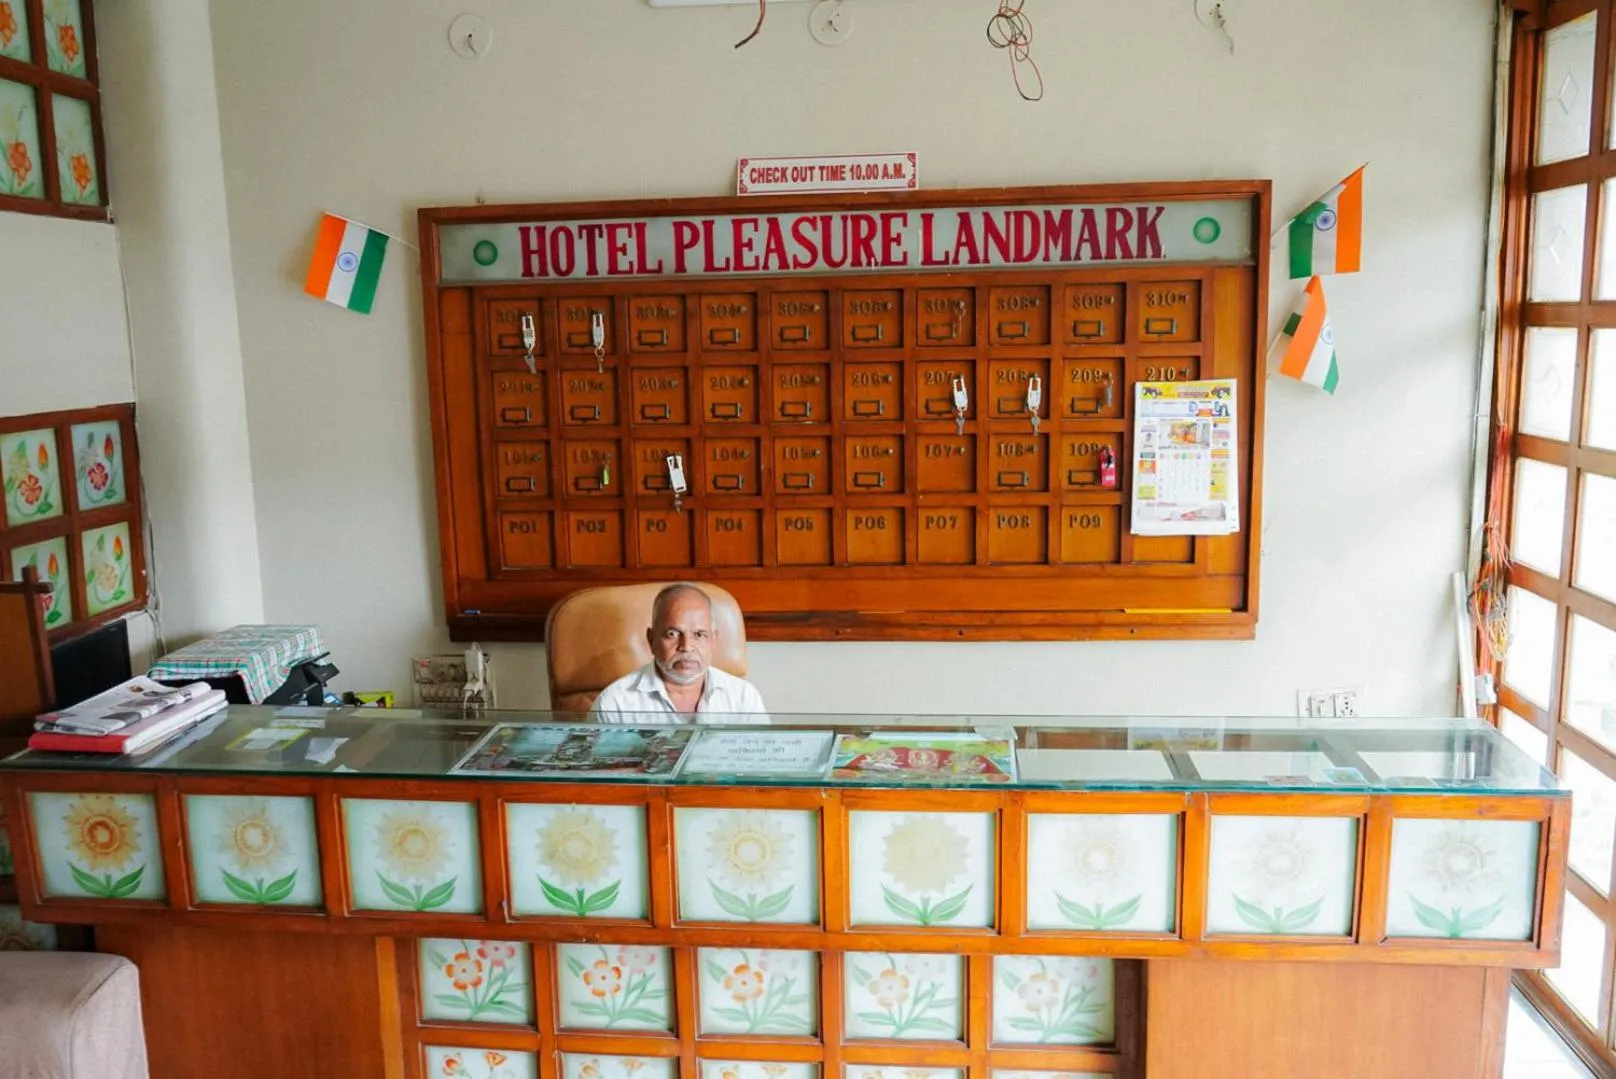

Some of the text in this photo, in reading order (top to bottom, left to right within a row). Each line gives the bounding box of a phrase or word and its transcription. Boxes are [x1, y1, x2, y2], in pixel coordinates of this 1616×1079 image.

[749, 162, 906, 184] CHECK OUT TIME 10.00 A.M.
[518, 206, 1166, 278] HOTEL PLEASURE LANDMARK
[1147, 291, 1175, 306] 310
[1072, 368, 1102, 383] 209
[1147, 367, 1175, 381] 210
[925, 444, 951, 458] 107
